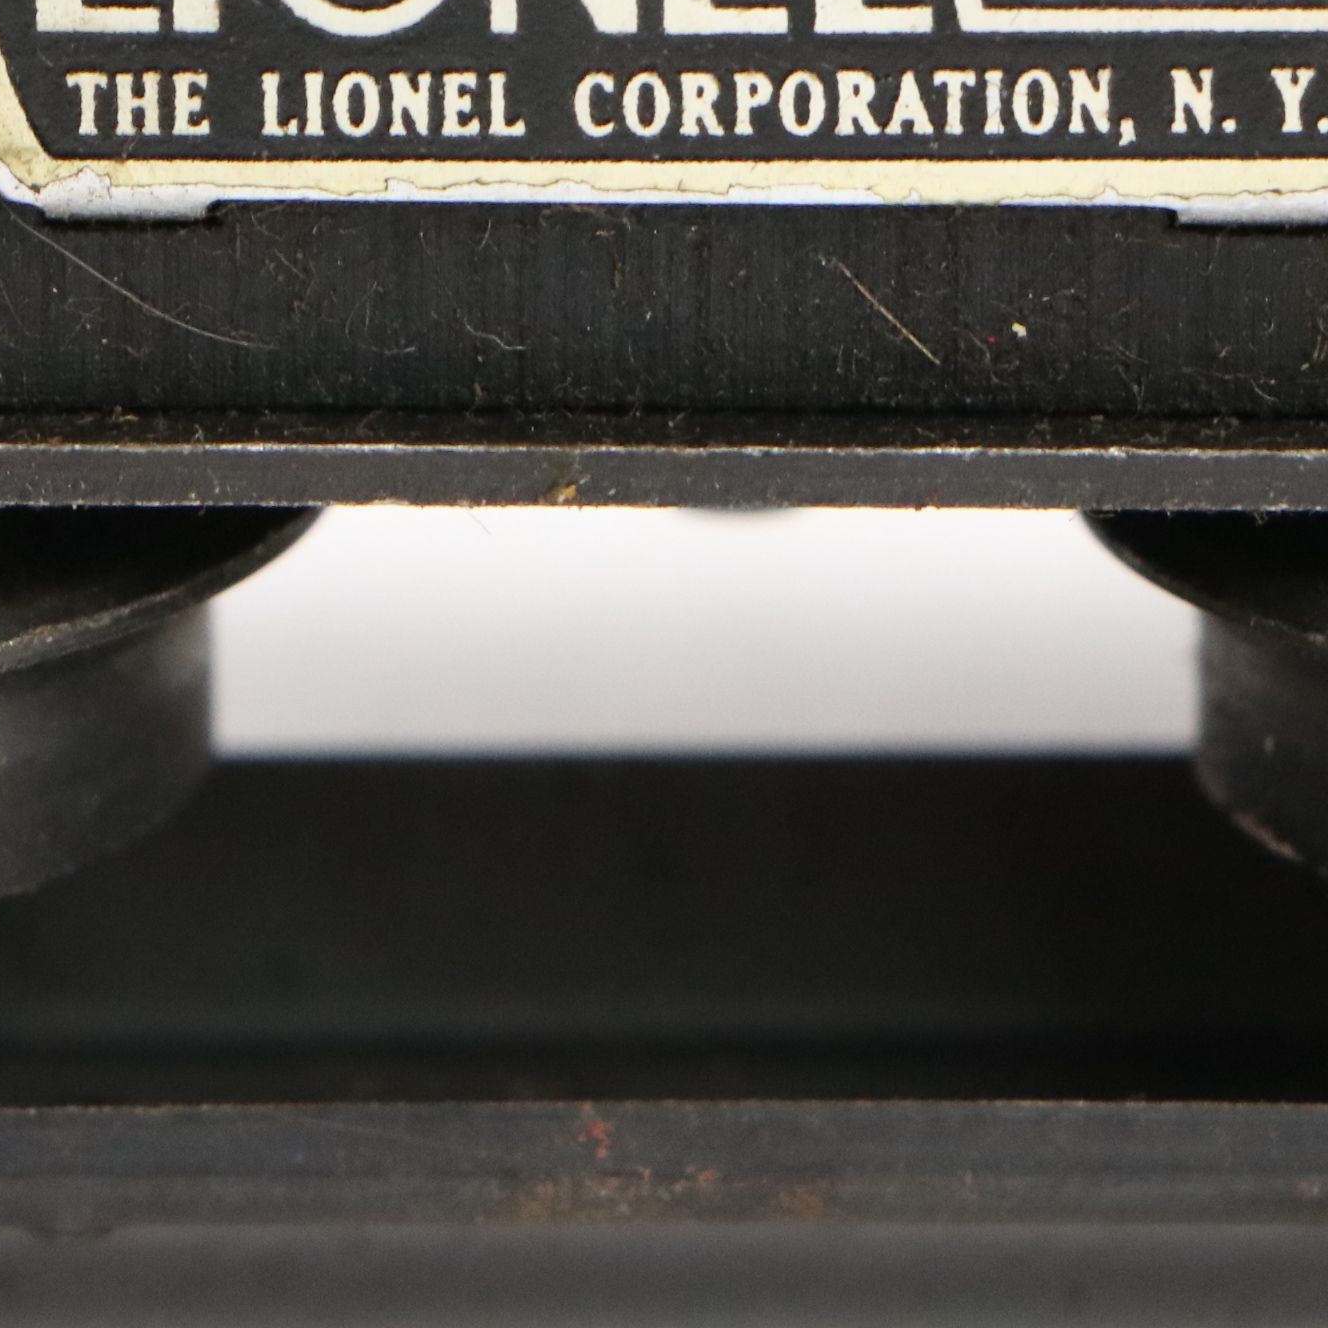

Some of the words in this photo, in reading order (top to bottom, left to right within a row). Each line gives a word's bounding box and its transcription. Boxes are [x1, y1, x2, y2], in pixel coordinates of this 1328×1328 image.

[65, 70, 211, 138] THE
[261, 70, 527, 139] LIONEL
[573, 67, 1137, 148] CORPORATION,
